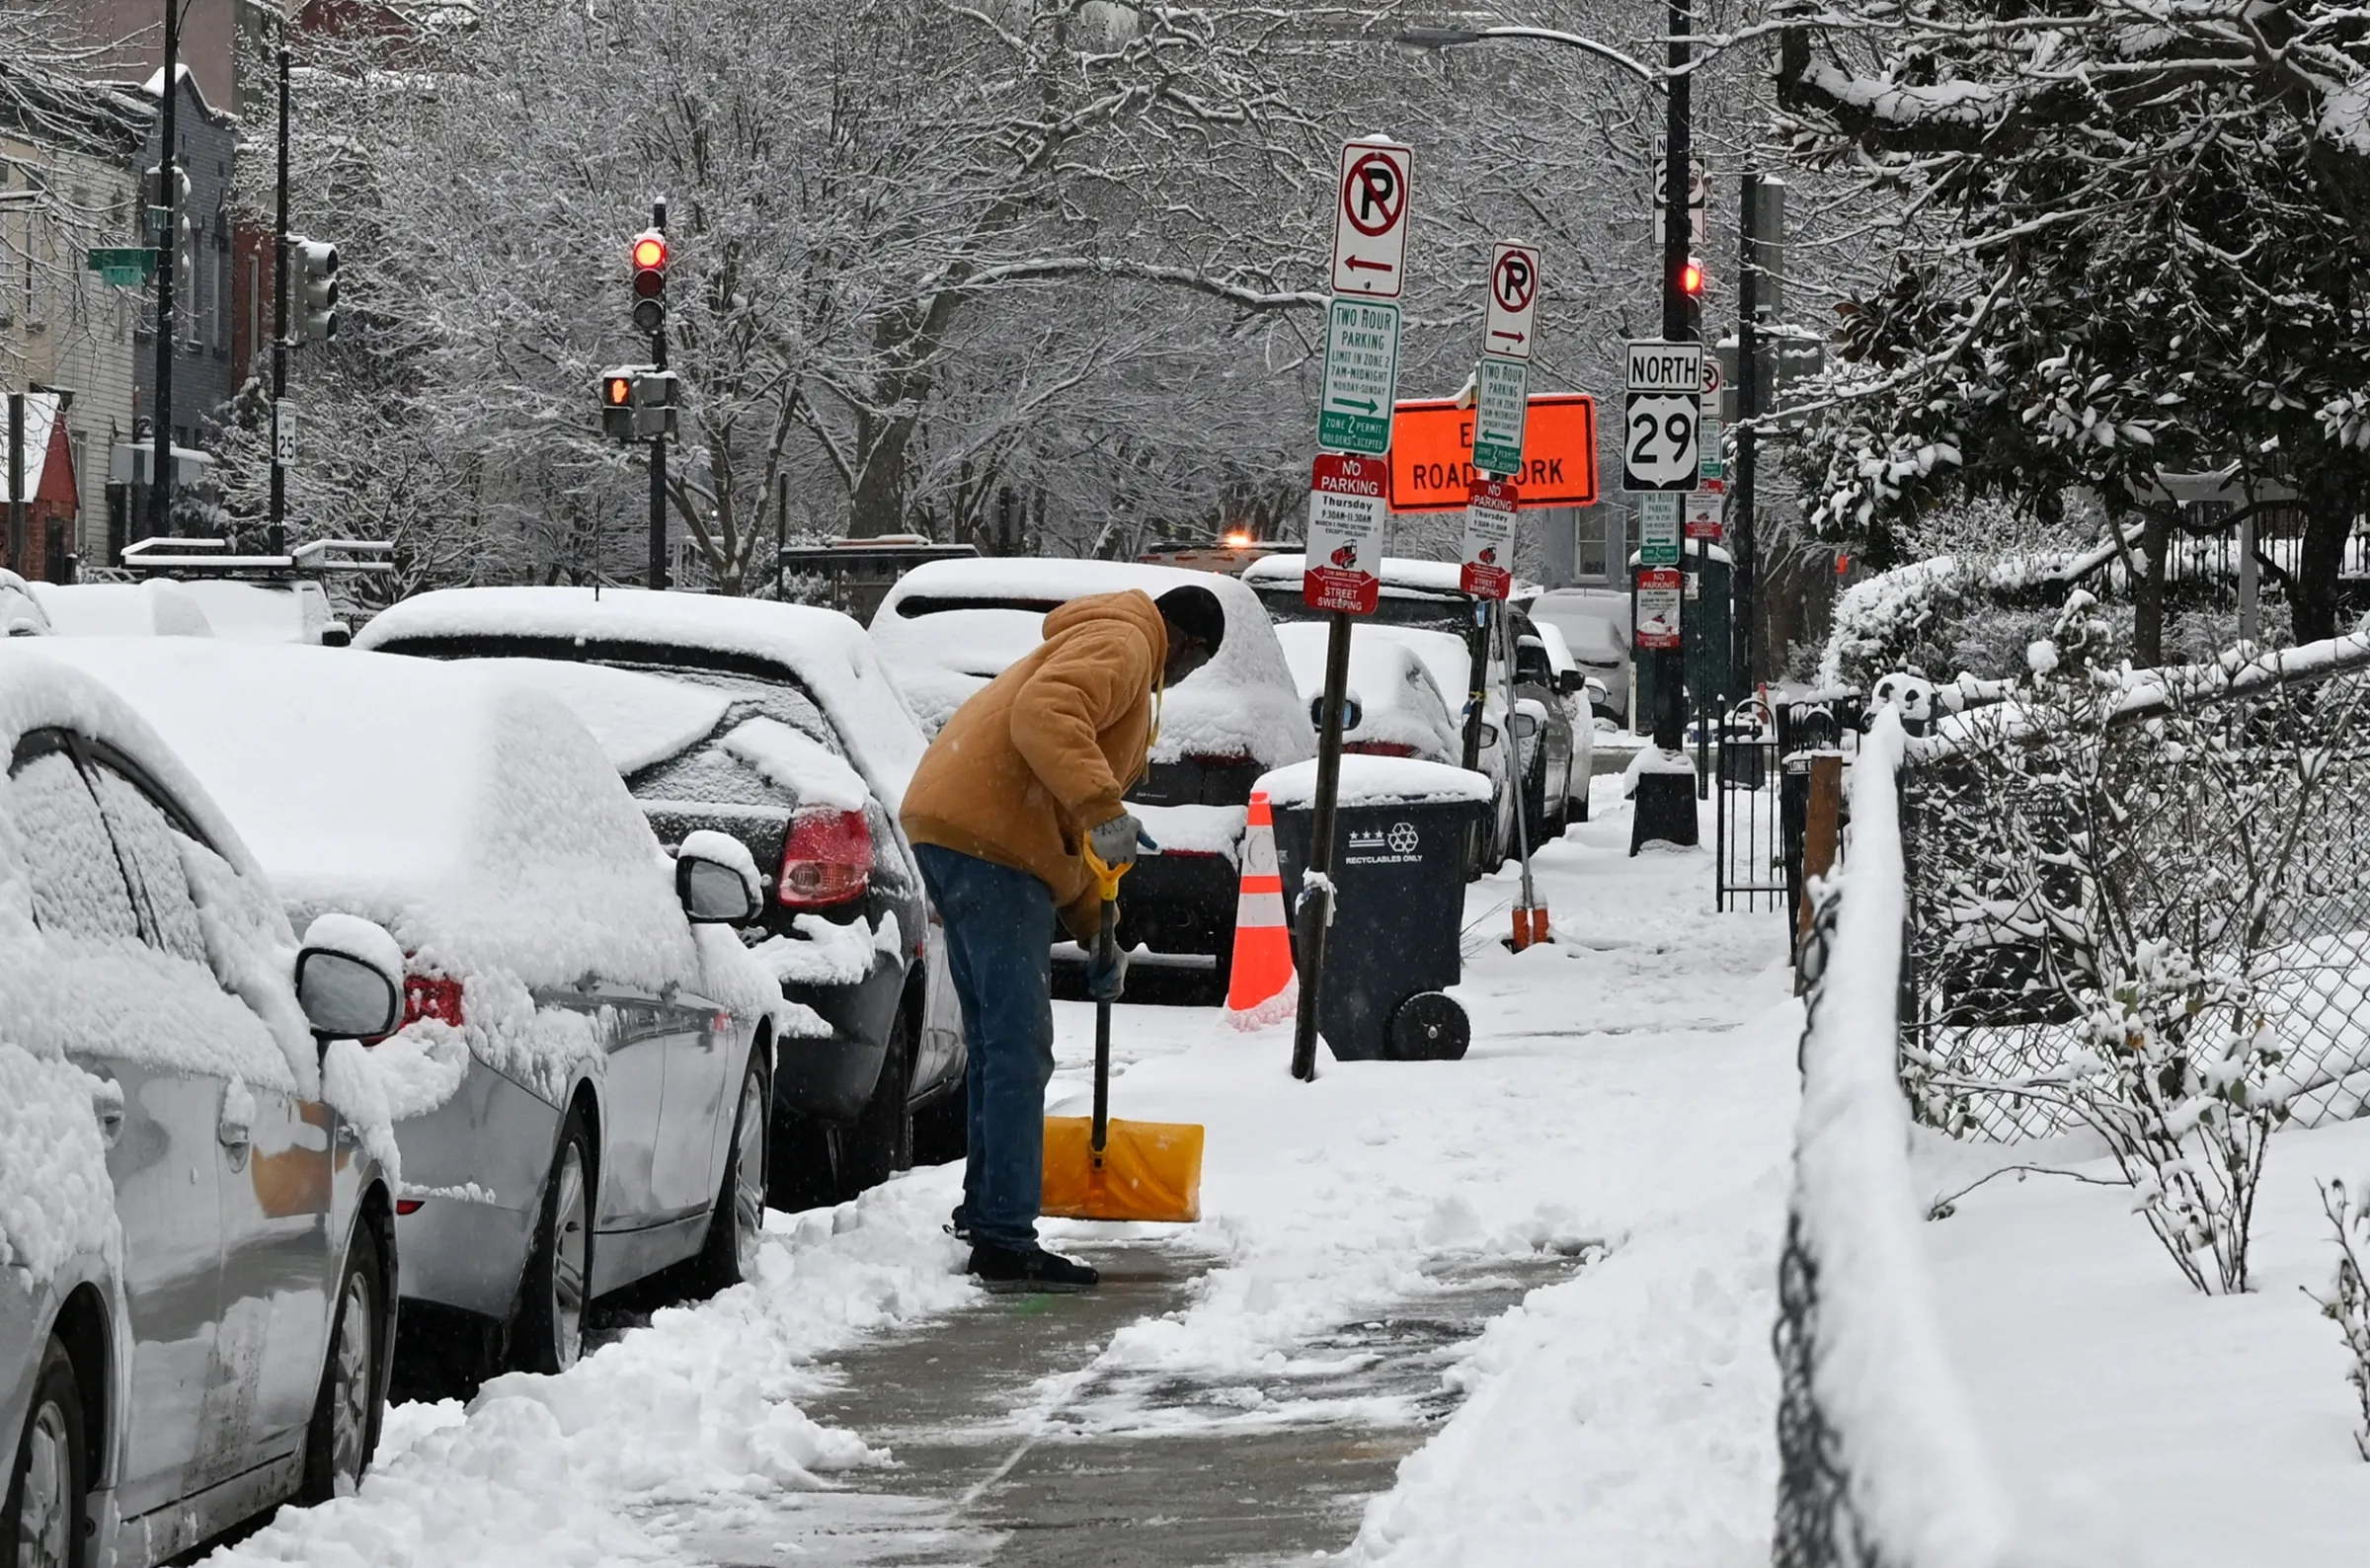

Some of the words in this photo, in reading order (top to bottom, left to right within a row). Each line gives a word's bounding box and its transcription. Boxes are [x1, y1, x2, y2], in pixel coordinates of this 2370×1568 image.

[1336, 307, 1357, 327] TWO
[1361, 308, 1391, 331] HOUR
[1341, 331, 1384, 351] PARKING
[1331, 350, 1351, 362] LIMIT
[1354, 353, 1362, 364] IN
[1364, 353, 1382, 367] ZONE
[1384, 356, 1390, 368] 2
[1331, 365, 1388, 383] 7AM-MIDNIGHT
[1485, 364, 1500, 379] TWO
[1502, 365, 1523, 383] HOUR
[1632, 356, 1698, 383] NORTH
[1488, 382, 1518, 398] PARKING
[1325, 417, 1346, 430] ZONE
[1348, 415, 1356, 433] 2
[1356, 421, 1382, 434] PERMIT
[279, 434, 294, 460] 25
[1631, 413, 1692, 464] 29
[1342, 461, 1362, 476] NO
[1514, 458, 1564, 486] ORK
[1321, 476, 1379, 496] PARKING
[1488, 484, 1501, 497] NO
[1322, 495, 1373, 512] Thursday
[1473, 495, 1512, 511] PARKING
[1324, 587, 1358, 599] STREET
[1642, 581, 1676, 589] PARKING
[1317, 596, 1362, 611] SWEEPING
[1345, 855, 1401, 865] RECYCLABLES
